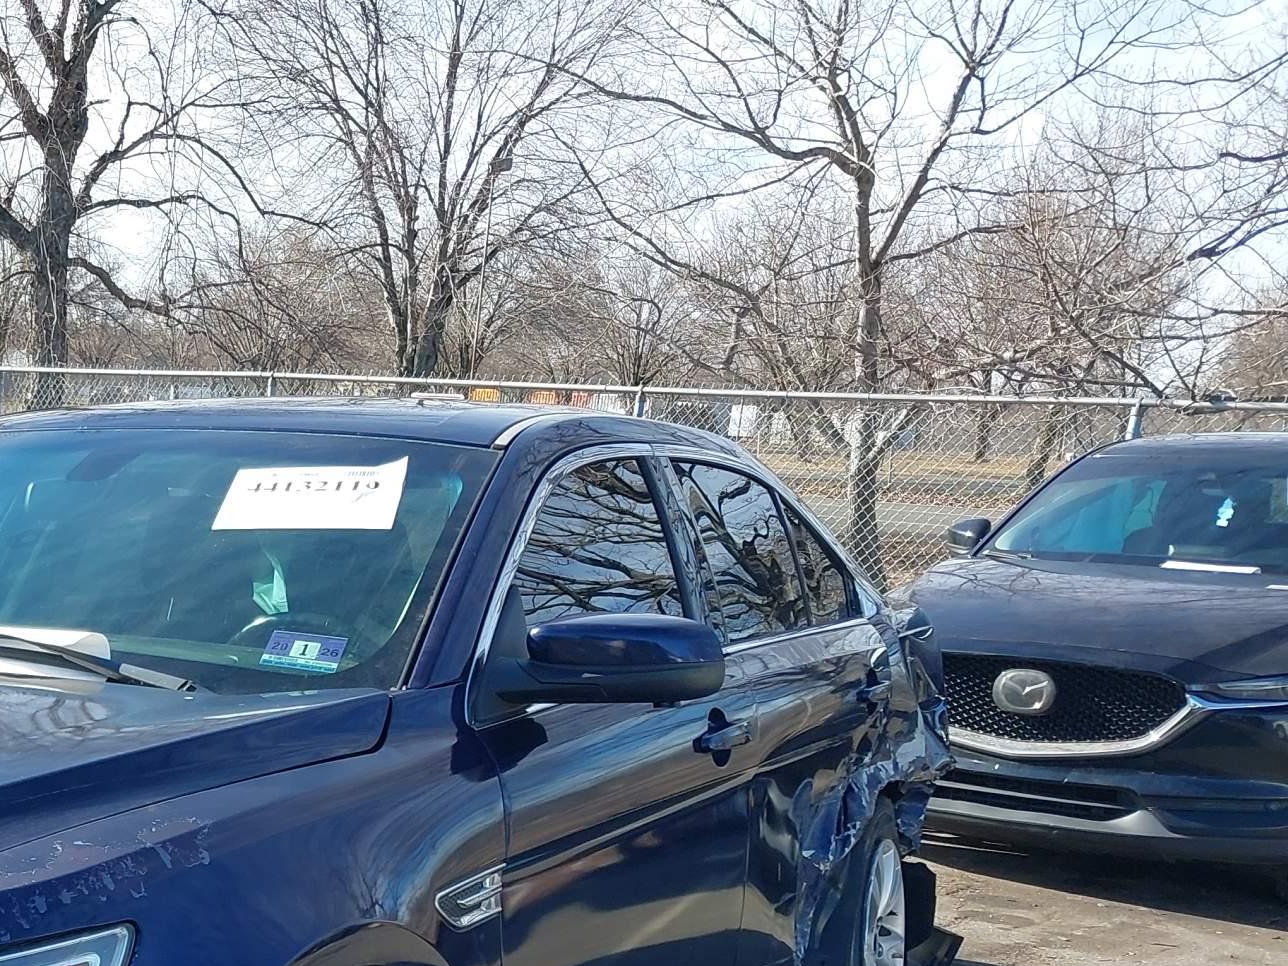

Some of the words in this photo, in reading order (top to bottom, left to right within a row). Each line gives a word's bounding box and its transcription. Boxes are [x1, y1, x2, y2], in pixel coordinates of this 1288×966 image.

[271, 641, 289, 651] 20
[298, 643, 309, 657] 1
[320, 648, 339, 658] 26
